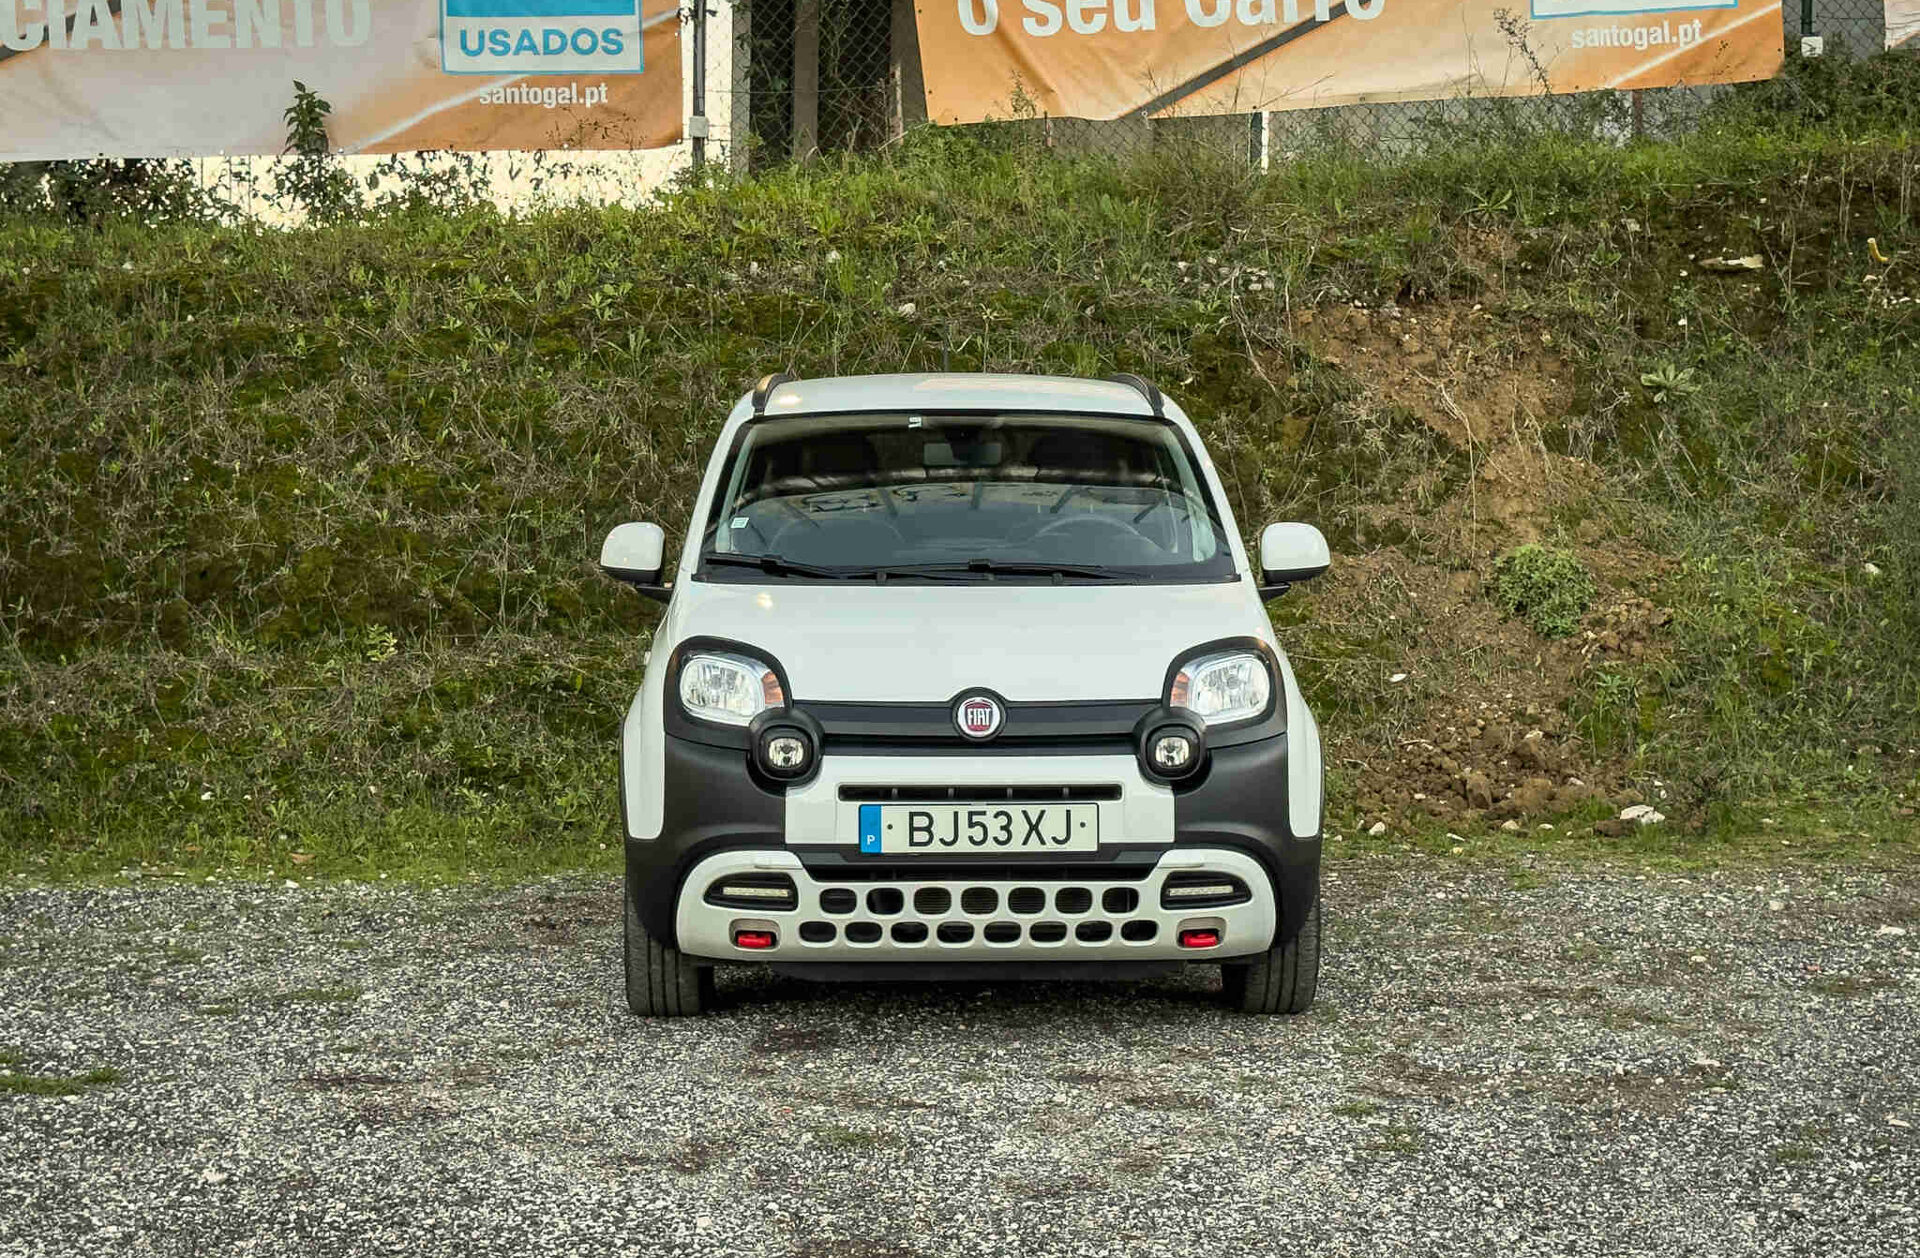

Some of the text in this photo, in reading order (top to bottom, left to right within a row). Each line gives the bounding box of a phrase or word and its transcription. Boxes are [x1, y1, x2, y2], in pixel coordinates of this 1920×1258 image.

[460, 28, 624, 57] USADOS
[1571, 19, 1702, 50] santogal.pt
[480, 82, 609, 108] santogal.pt
[967, 707, 992, 726] FIAT
